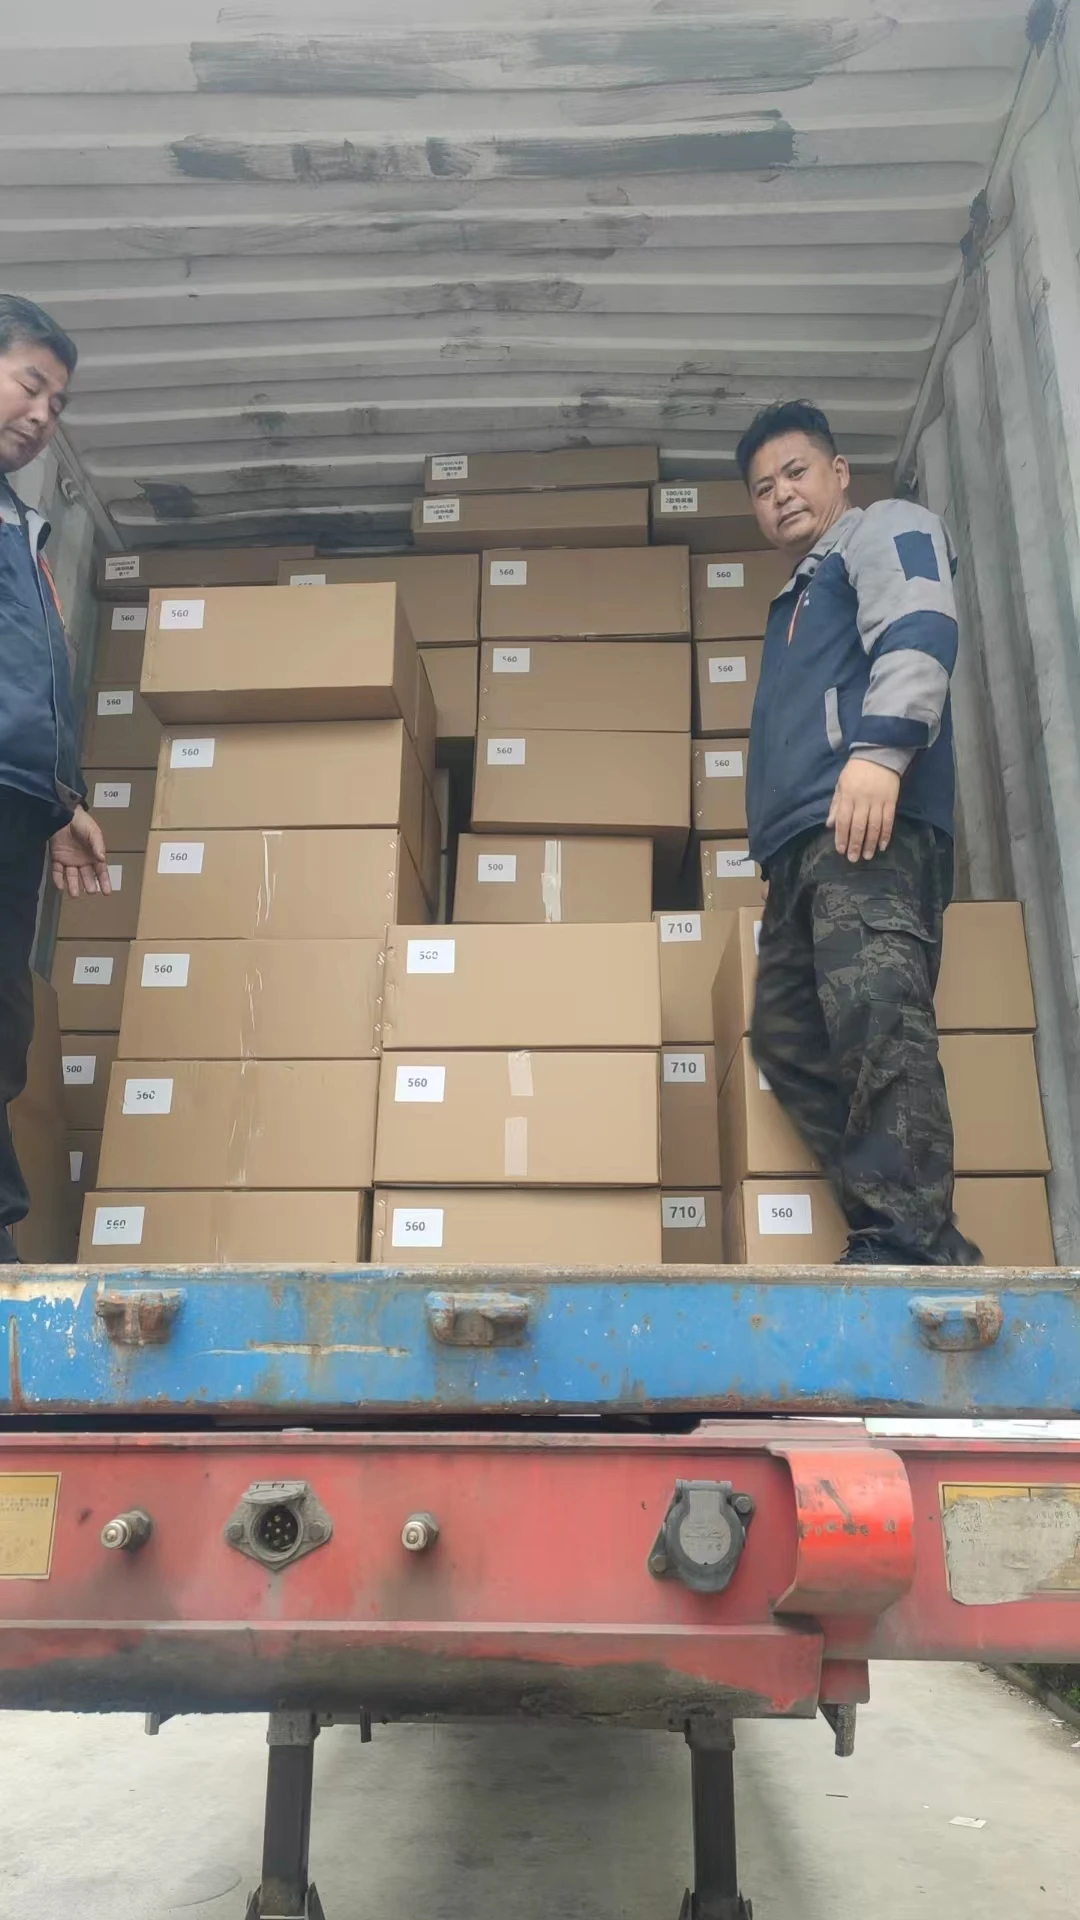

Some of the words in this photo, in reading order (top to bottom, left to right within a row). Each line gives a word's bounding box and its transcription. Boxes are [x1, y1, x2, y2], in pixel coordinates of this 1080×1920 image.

[499, 568, 515, 576] 560
[716, 571, 732, 579] 560
[120, 614, 135, 622] 560
[171, 609, 189, 618] 560
[717, 664, 734, 673] 560
[181, 747, 200, 757] 560
[496, 746, 513, 755] 560
[714, 759, 730, 767] 560
[169, 852, 188, 861] 560
[726, 857, 742, 867] 560
[487, 863, 504, 872] 500
[667, 922, 693, 935] 710
[83, 965, 100, 974] 500
[154, 964, 173, 974] 560
[66, 1065, 83, 1073] 500
[669, 1061, 697, 1074] 710
[407, 1077, 428, 1088] 560
[135, 1090, 156, 1100] 560
[669, 1205, 697, 1219] 710
[771, 1207, 793, 1218] 560
[105, 1219, 127, 1230] 560
[405, 1221, 426, 1232] 560
